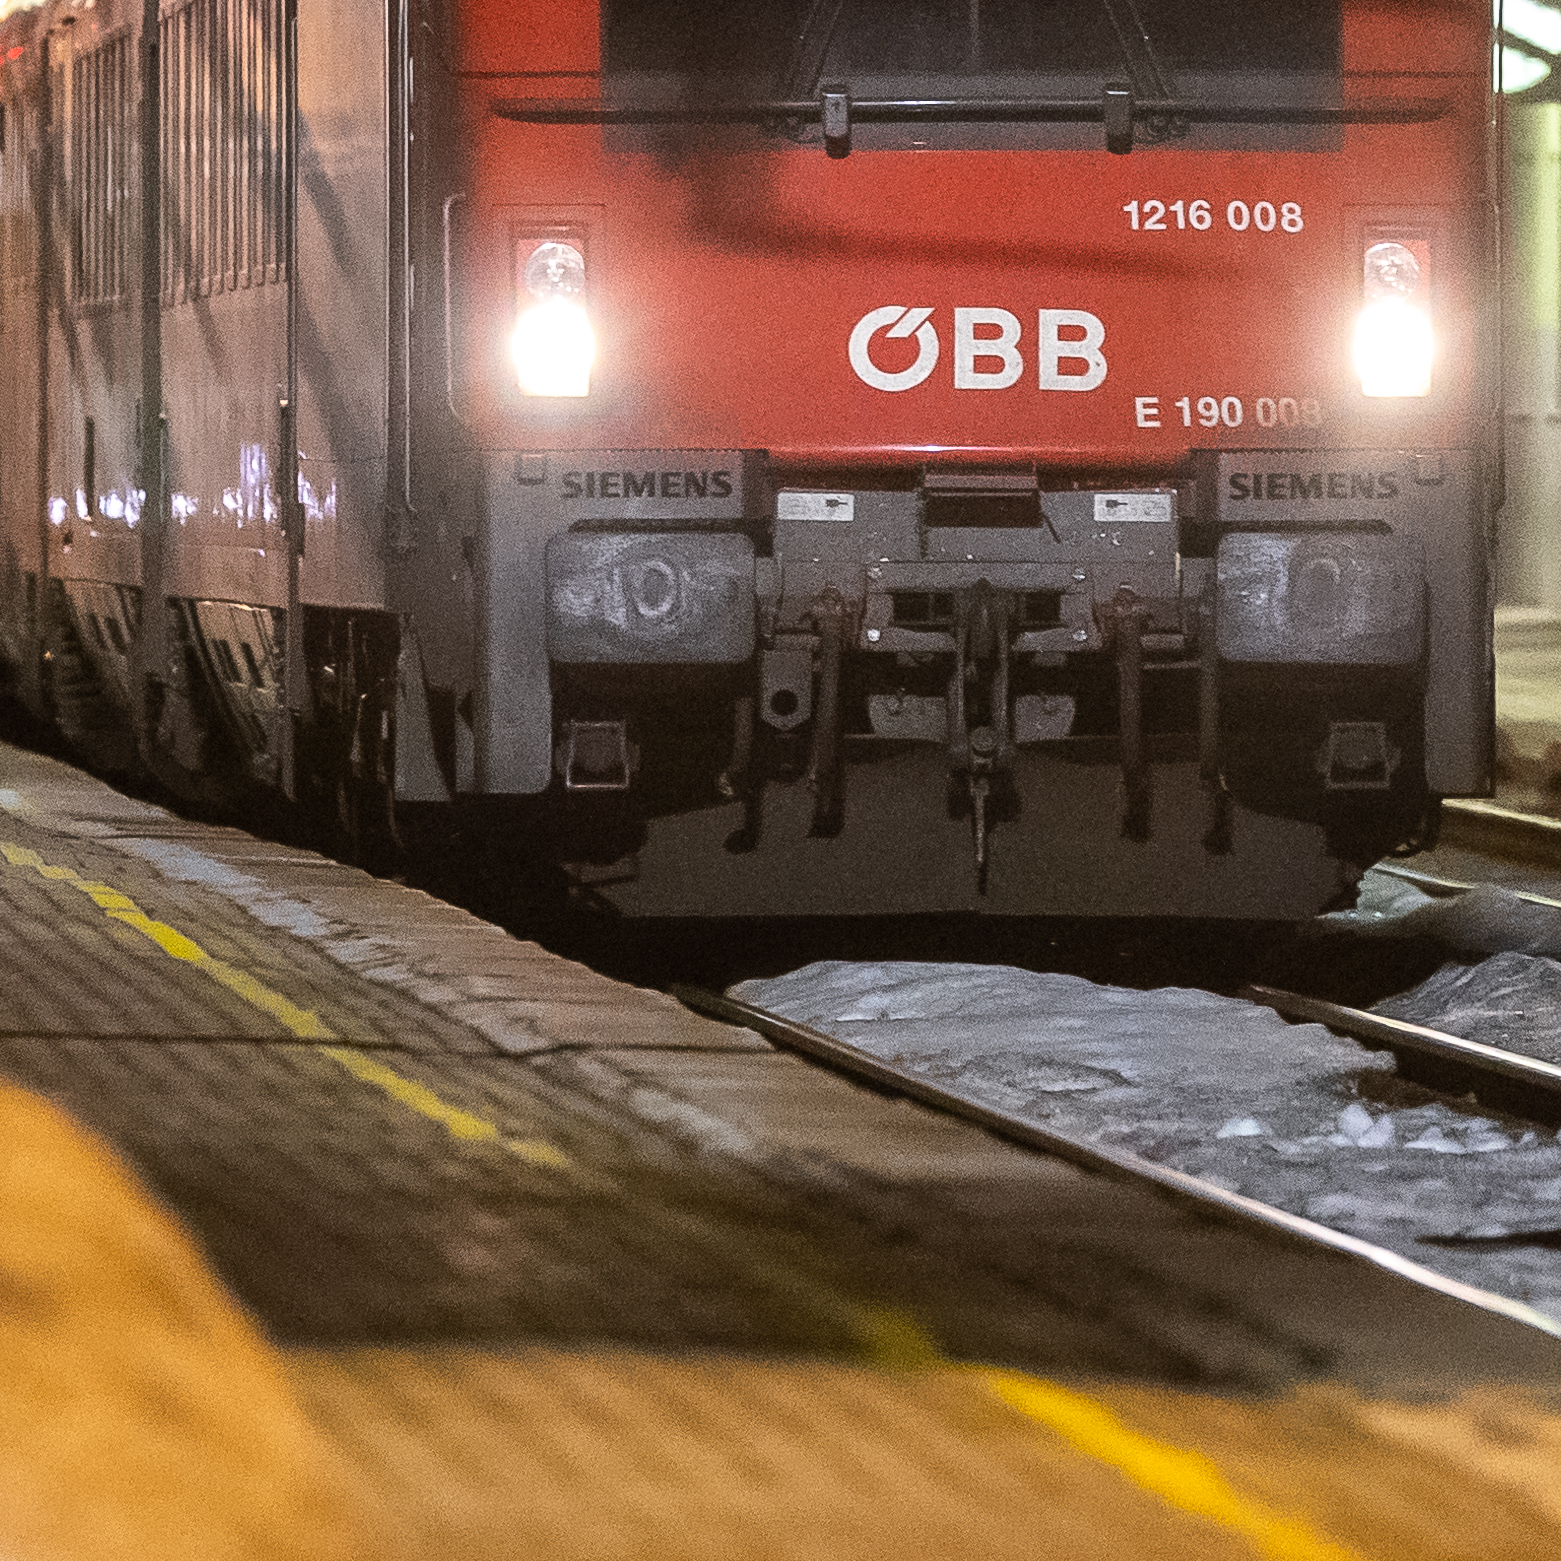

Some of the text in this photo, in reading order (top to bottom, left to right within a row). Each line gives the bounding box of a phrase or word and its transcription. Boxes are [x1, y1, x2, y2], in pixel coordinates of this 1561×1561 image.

[1123, 199, 1305, 234] 1216 008
[847, 304, 1109, 392] ÖBB
[1134, 396, 1162, 428] E
[1174, 395, 1244, 428] 190
[560, 469, 734, 500] SIEMENS
[1229, 471, 1400, 501] SIEMENS
